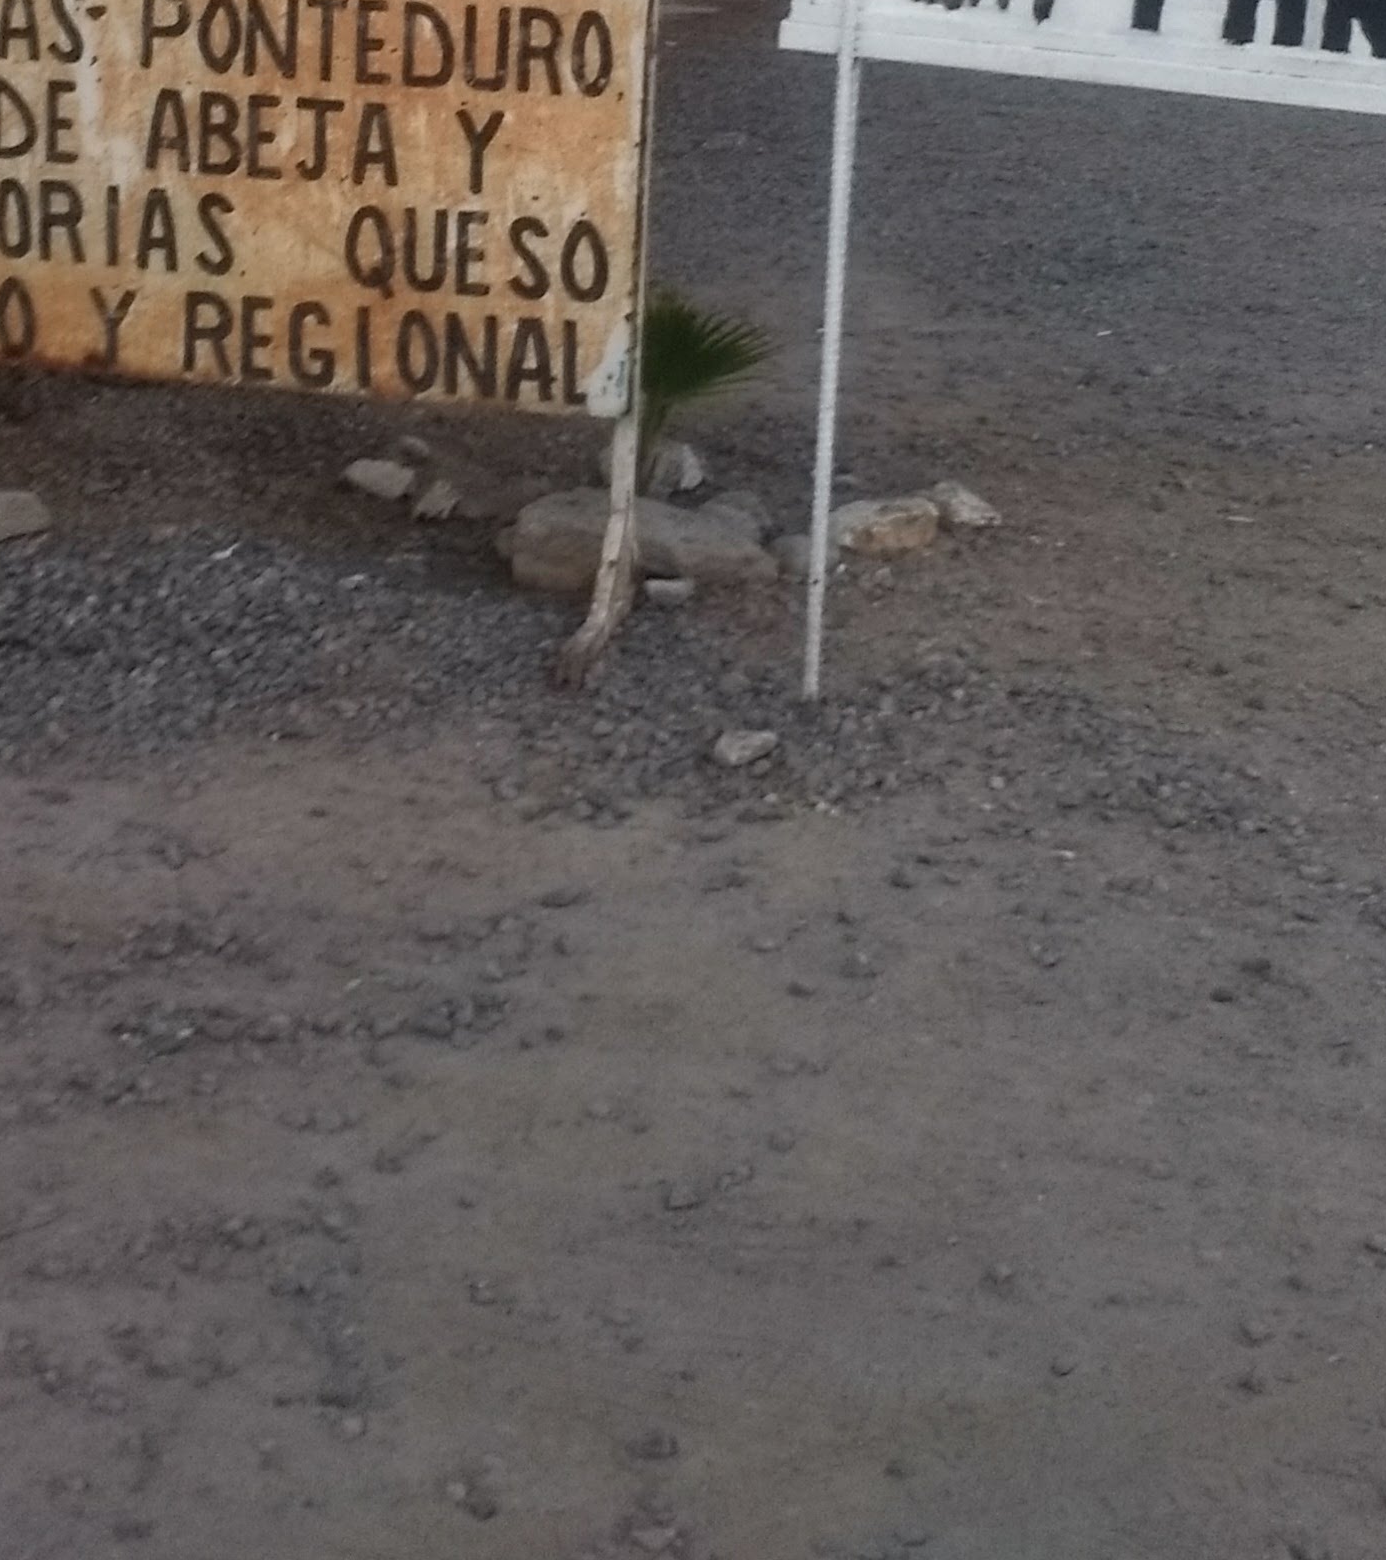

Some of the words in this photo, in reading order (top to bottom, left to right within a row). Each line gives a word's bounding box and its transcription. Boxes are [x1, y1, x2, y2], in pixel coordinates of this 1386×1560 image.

[145, 88, 399, 187] ABEJA
[455, 109, 505, 194] Y
[344, 205, 610, 304] QUESO
[89, 287, 137, 370] Y
[183, 290, 589, 405] REGIONAL
